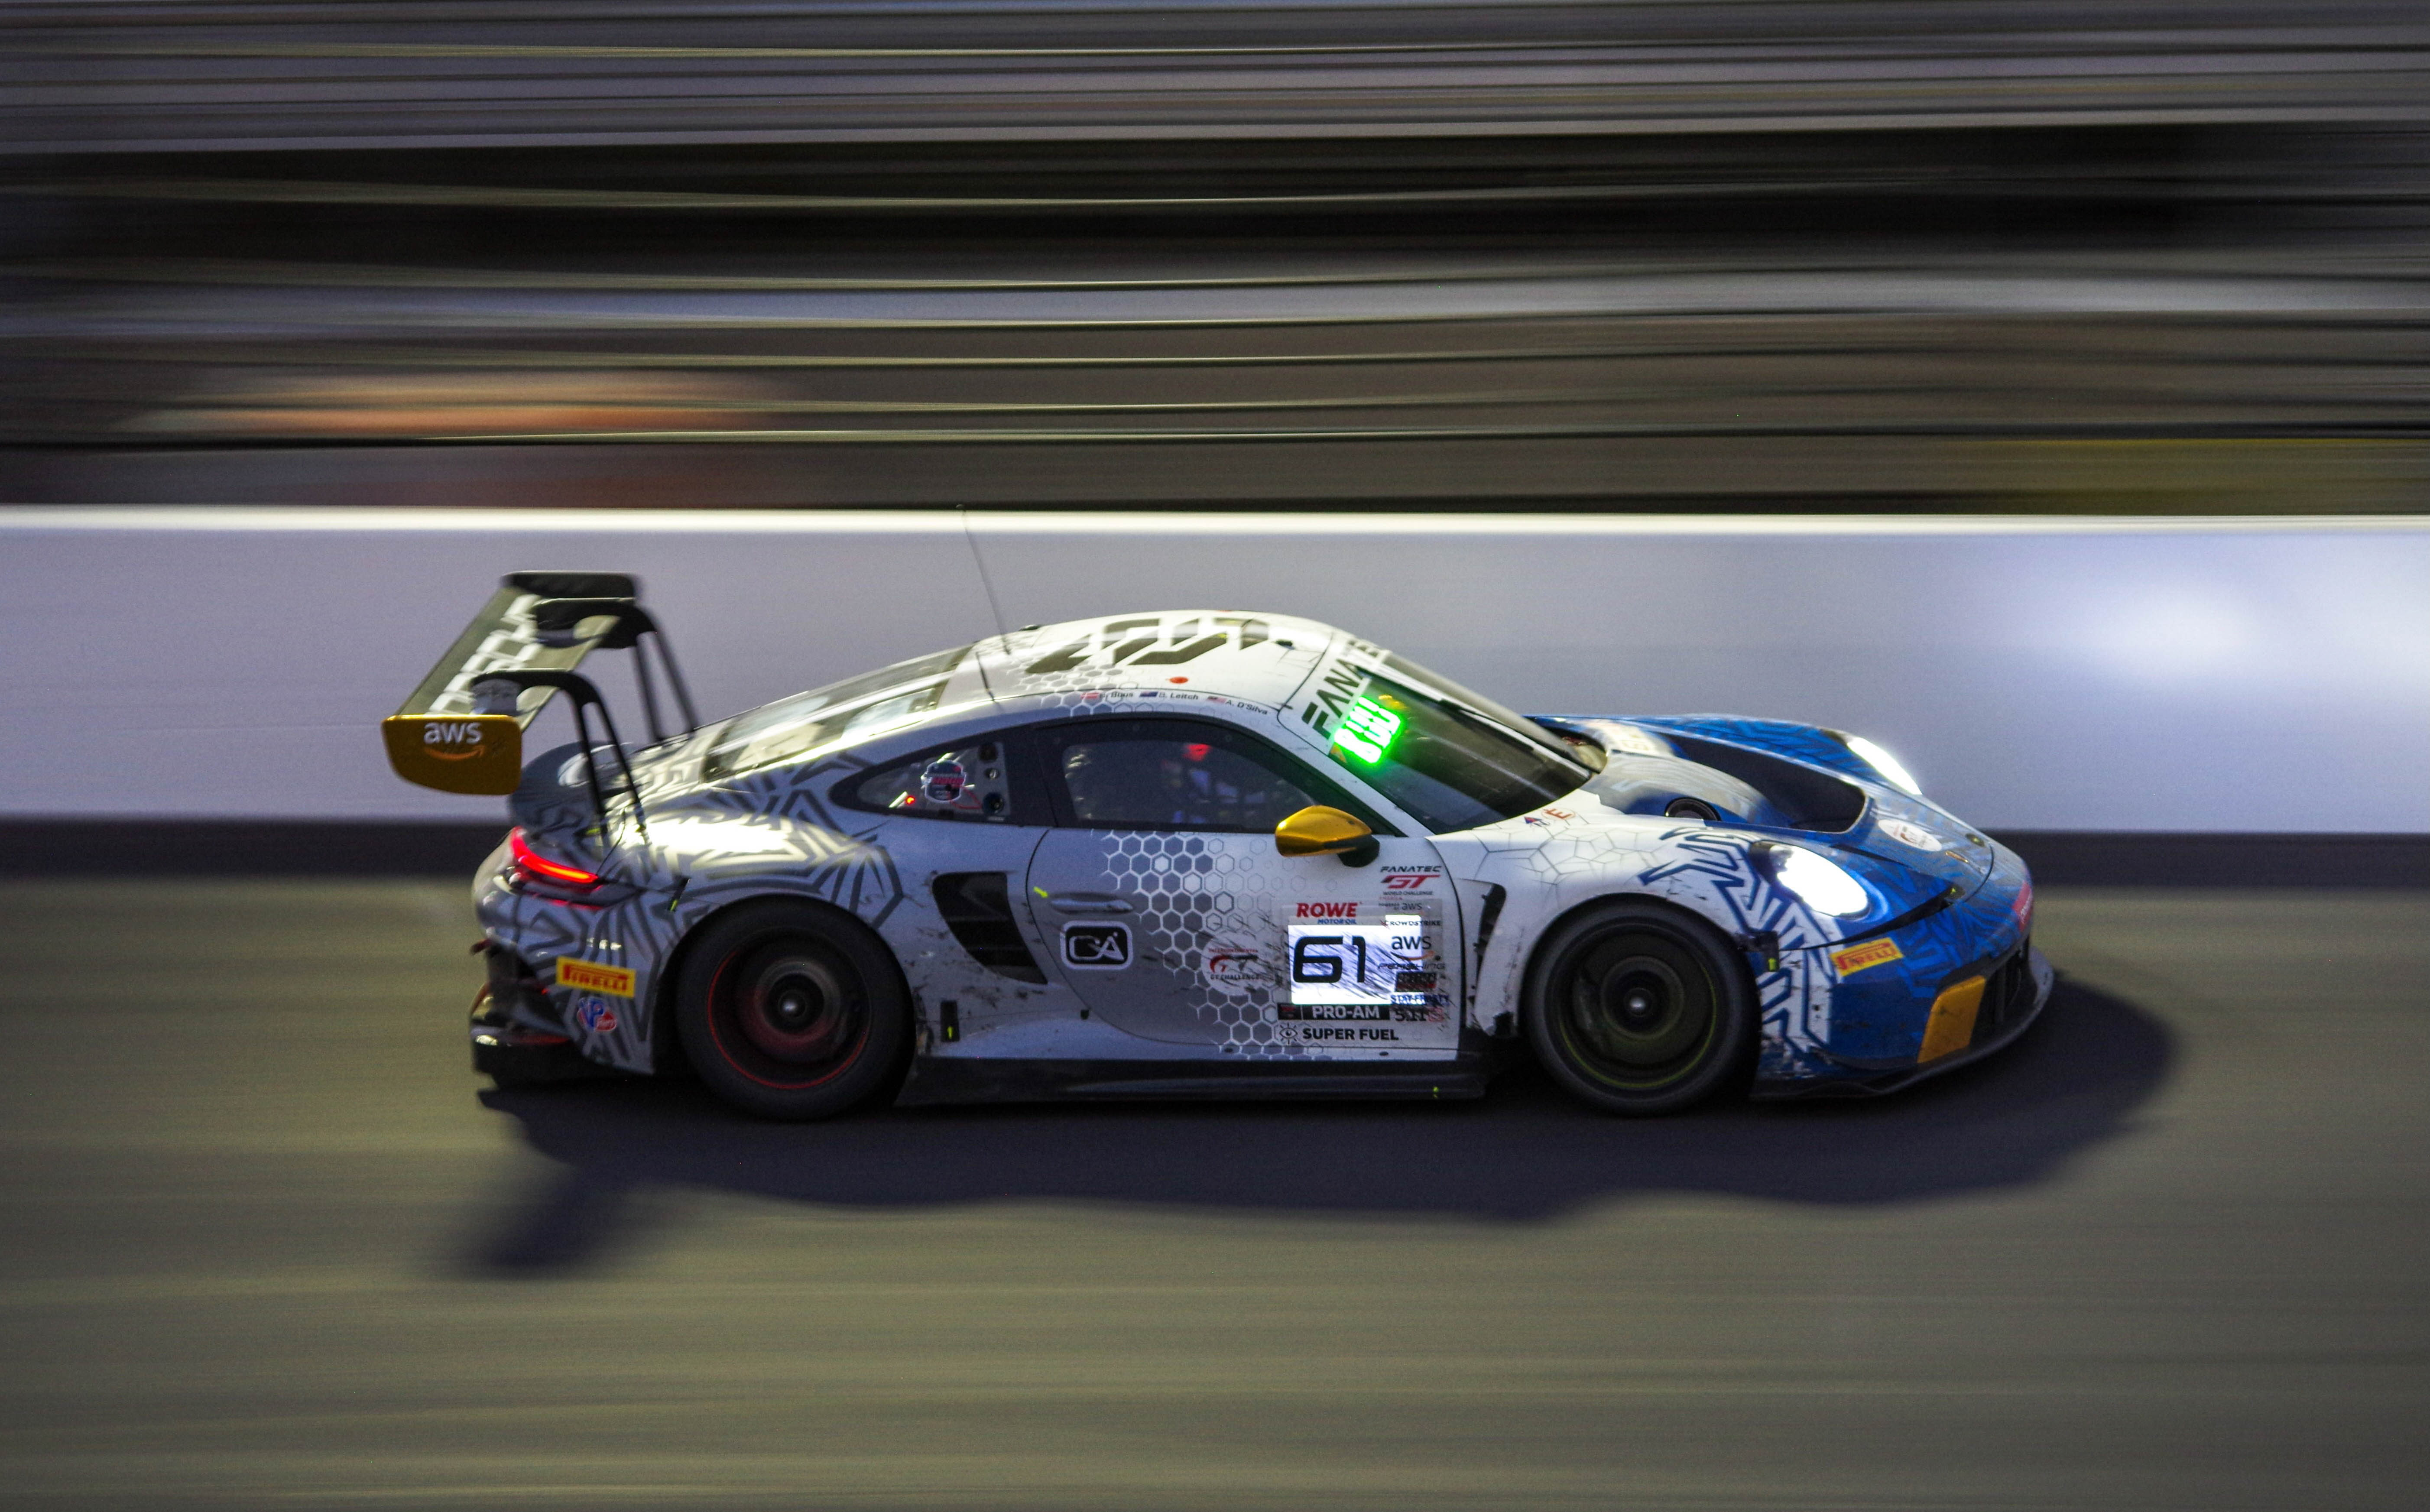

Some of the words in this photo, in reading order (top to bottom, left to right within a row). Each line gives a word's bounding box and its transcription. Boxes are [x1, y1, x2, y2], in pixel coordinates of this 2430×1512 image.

[1237, 702, 1268, 715] D'Silva
[423, 722, 482, 744] aws
[1296, 902, 1358, 918] ROWE
[1391, 936, 1432, 950] aws
[1293, 935, 1366, 983] 61
[564, 964, 628, 991] PIRELLI
[1312, 1005, 1380, 1019] PRO-AM
[1303, 1028, 1355, 1040] SUPER
[1359, 1029, 1399, 1040] FUEL
